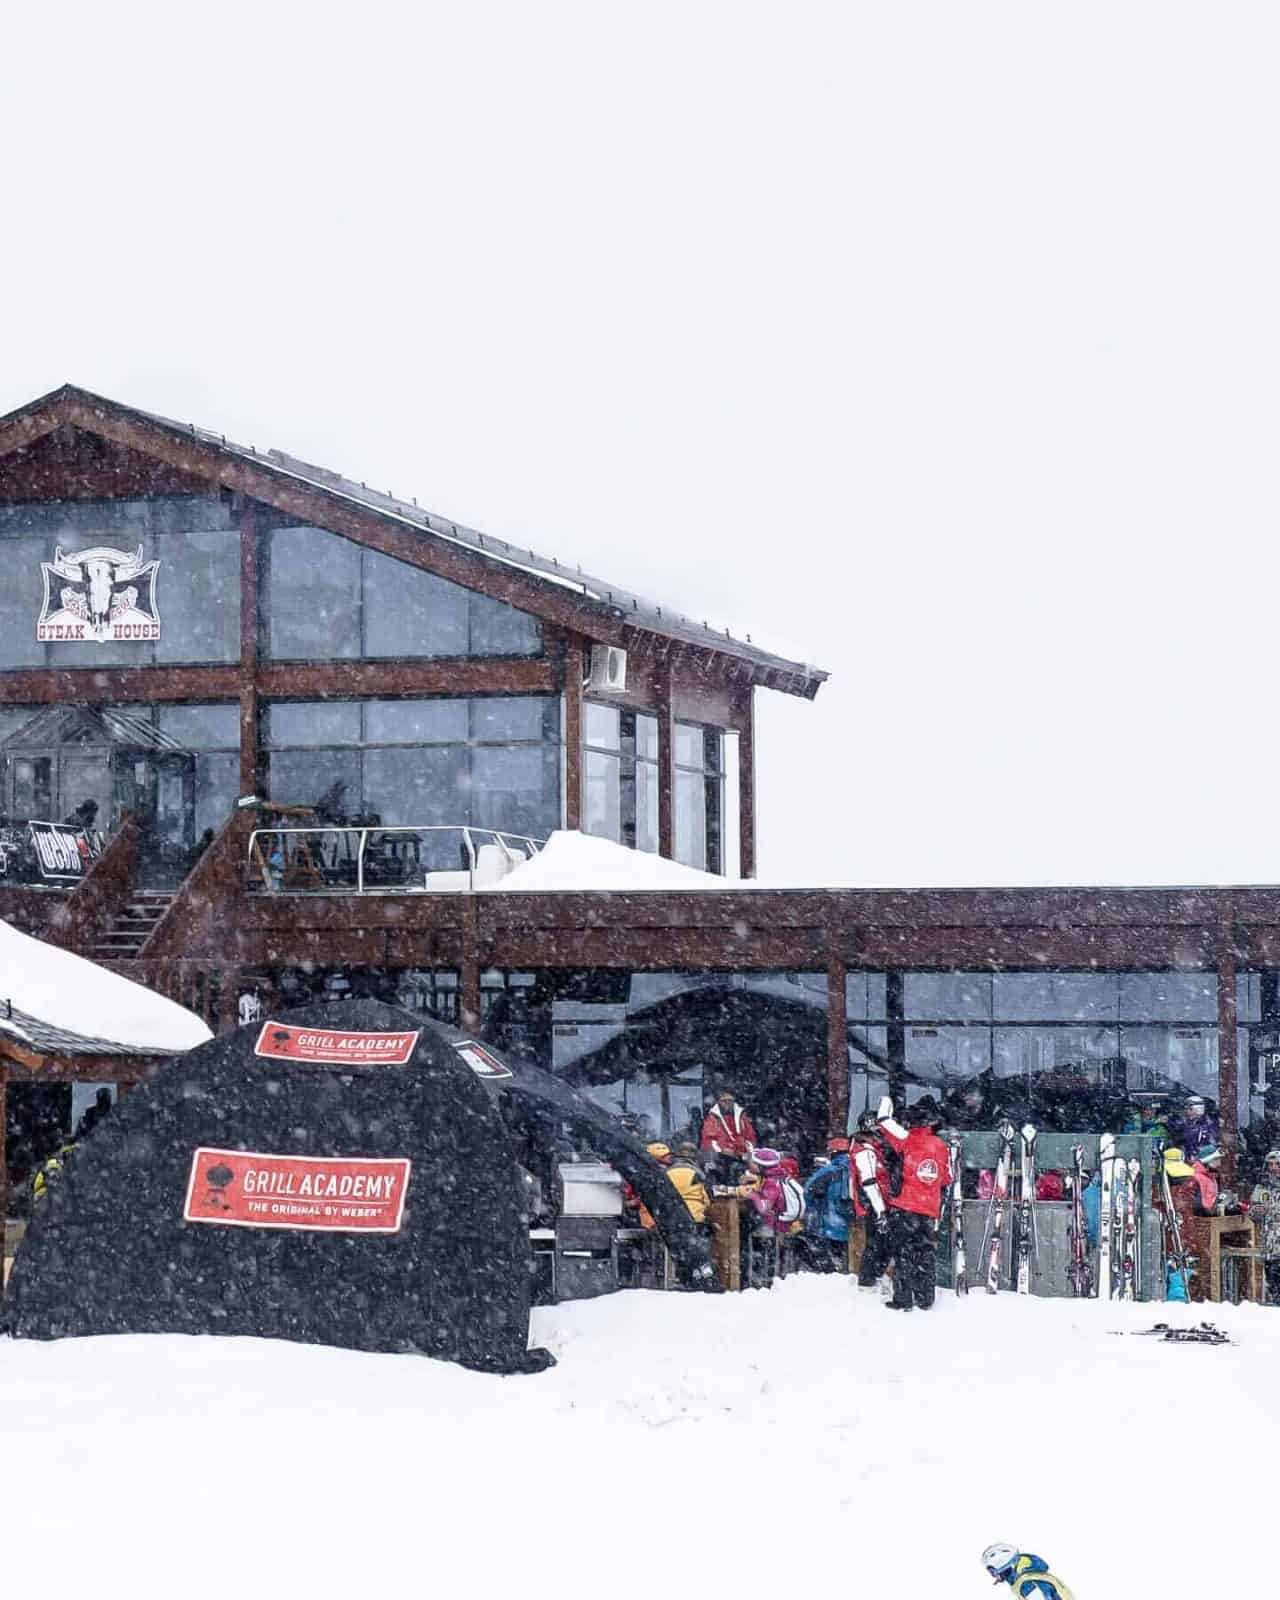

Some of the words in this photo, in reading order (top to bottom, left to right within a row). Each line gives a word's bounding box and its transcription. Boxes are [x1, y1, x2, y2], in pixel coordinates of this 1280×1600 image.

[39, 625, 85, 639] STEAK
[113, 624, 159, 639] HOUSE
[297, 1034, 335, 1049] GRILL
[337, 1038, 408, 1050] ACADEMY
[243, 1170, 296, 1195] GRILL
[299, 1174, 396, 1200] ACADEMY
[248, 1202, 268, 1213] THE
[271, 1204, 320, 1216] ORIGINAL
[325, 1207, 338, 1217] BY
